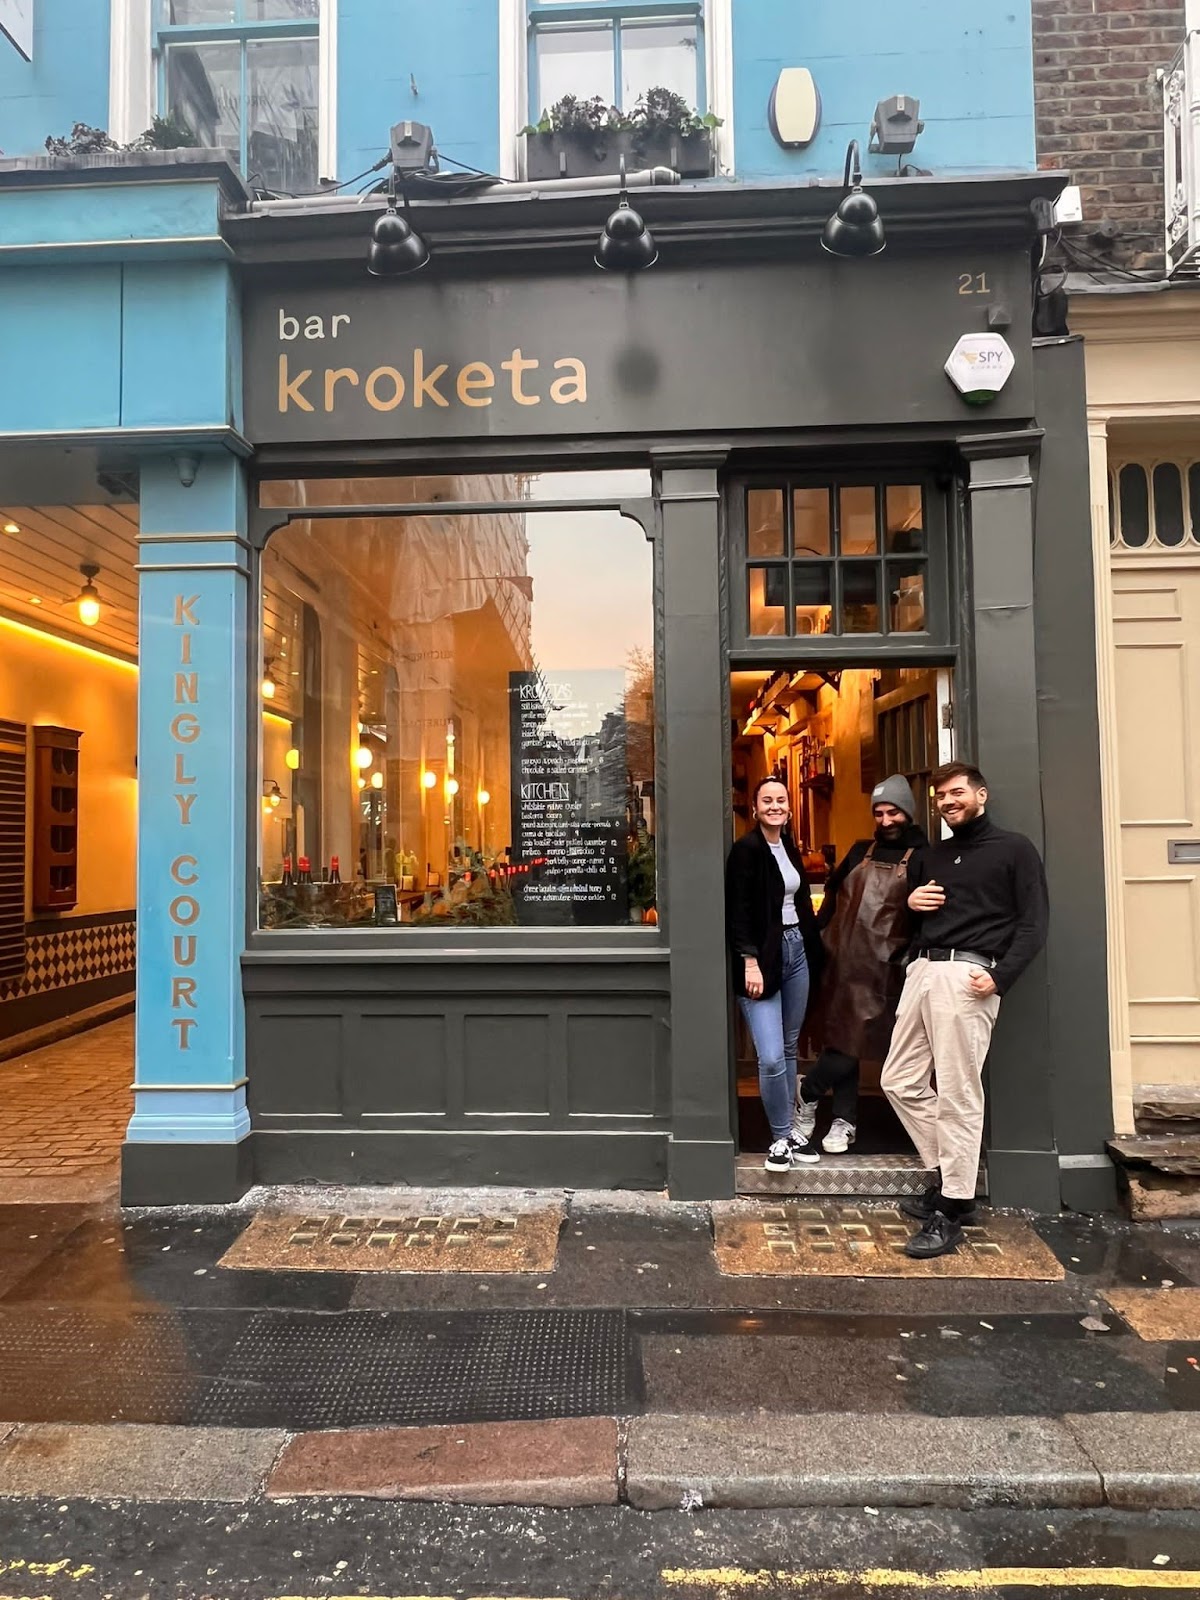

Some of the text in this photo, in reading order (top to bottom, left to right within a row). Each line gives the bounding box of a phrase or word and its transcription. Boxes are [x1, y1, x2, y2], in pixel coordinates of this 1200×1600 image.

[958, 272, 991, 295] 21
[279, 309, 350, 340] bar
[978, 351, 1003, 363] SPY
[278, 348, 588, 412] kroketa
[521, 783, 569, 799] KITCHEN
[169, 593, 201, 1051] KINGLY COURT
